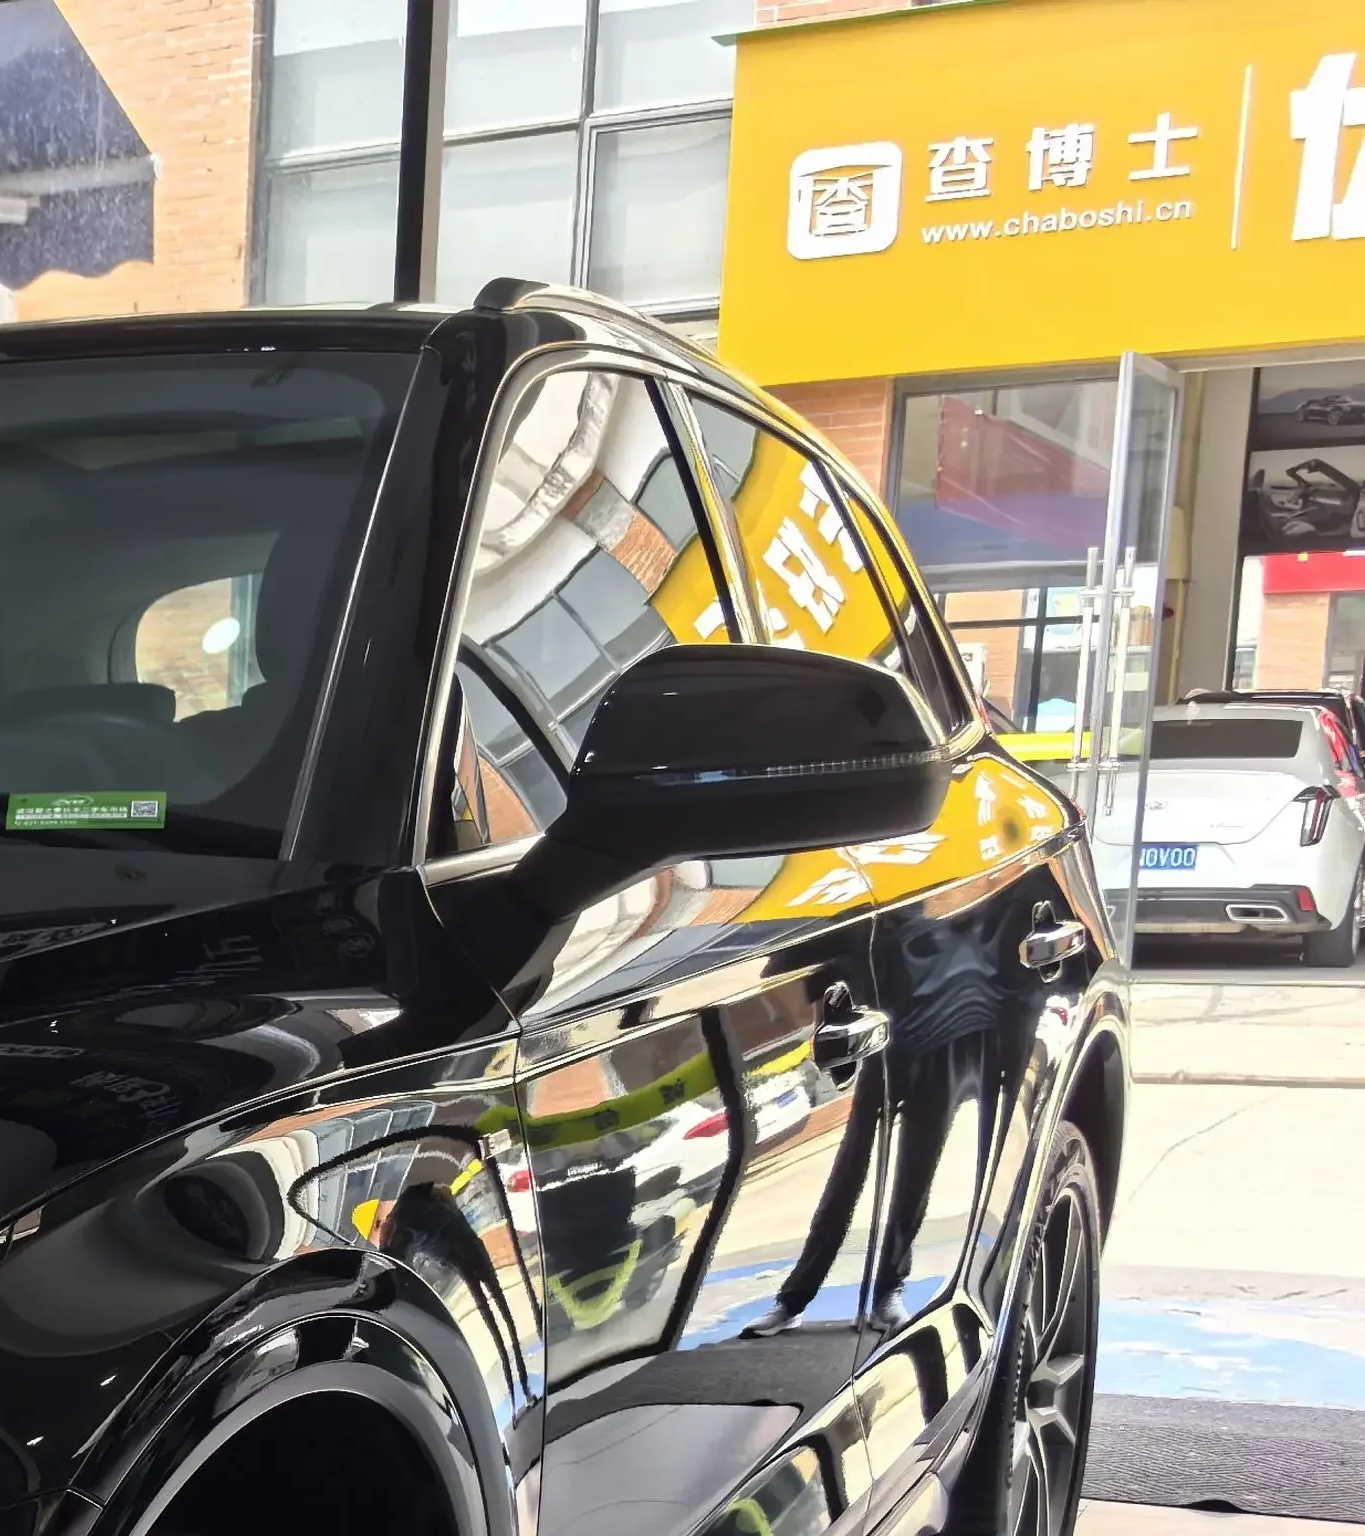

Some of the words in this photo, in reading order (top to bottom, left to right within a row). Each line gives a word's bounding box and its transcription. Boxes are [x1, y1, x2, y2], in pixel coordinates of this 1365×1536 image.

[925, 112, 1200, 204] 查博士
[921, 199, 1193, 244] www.chaboshi.cn
